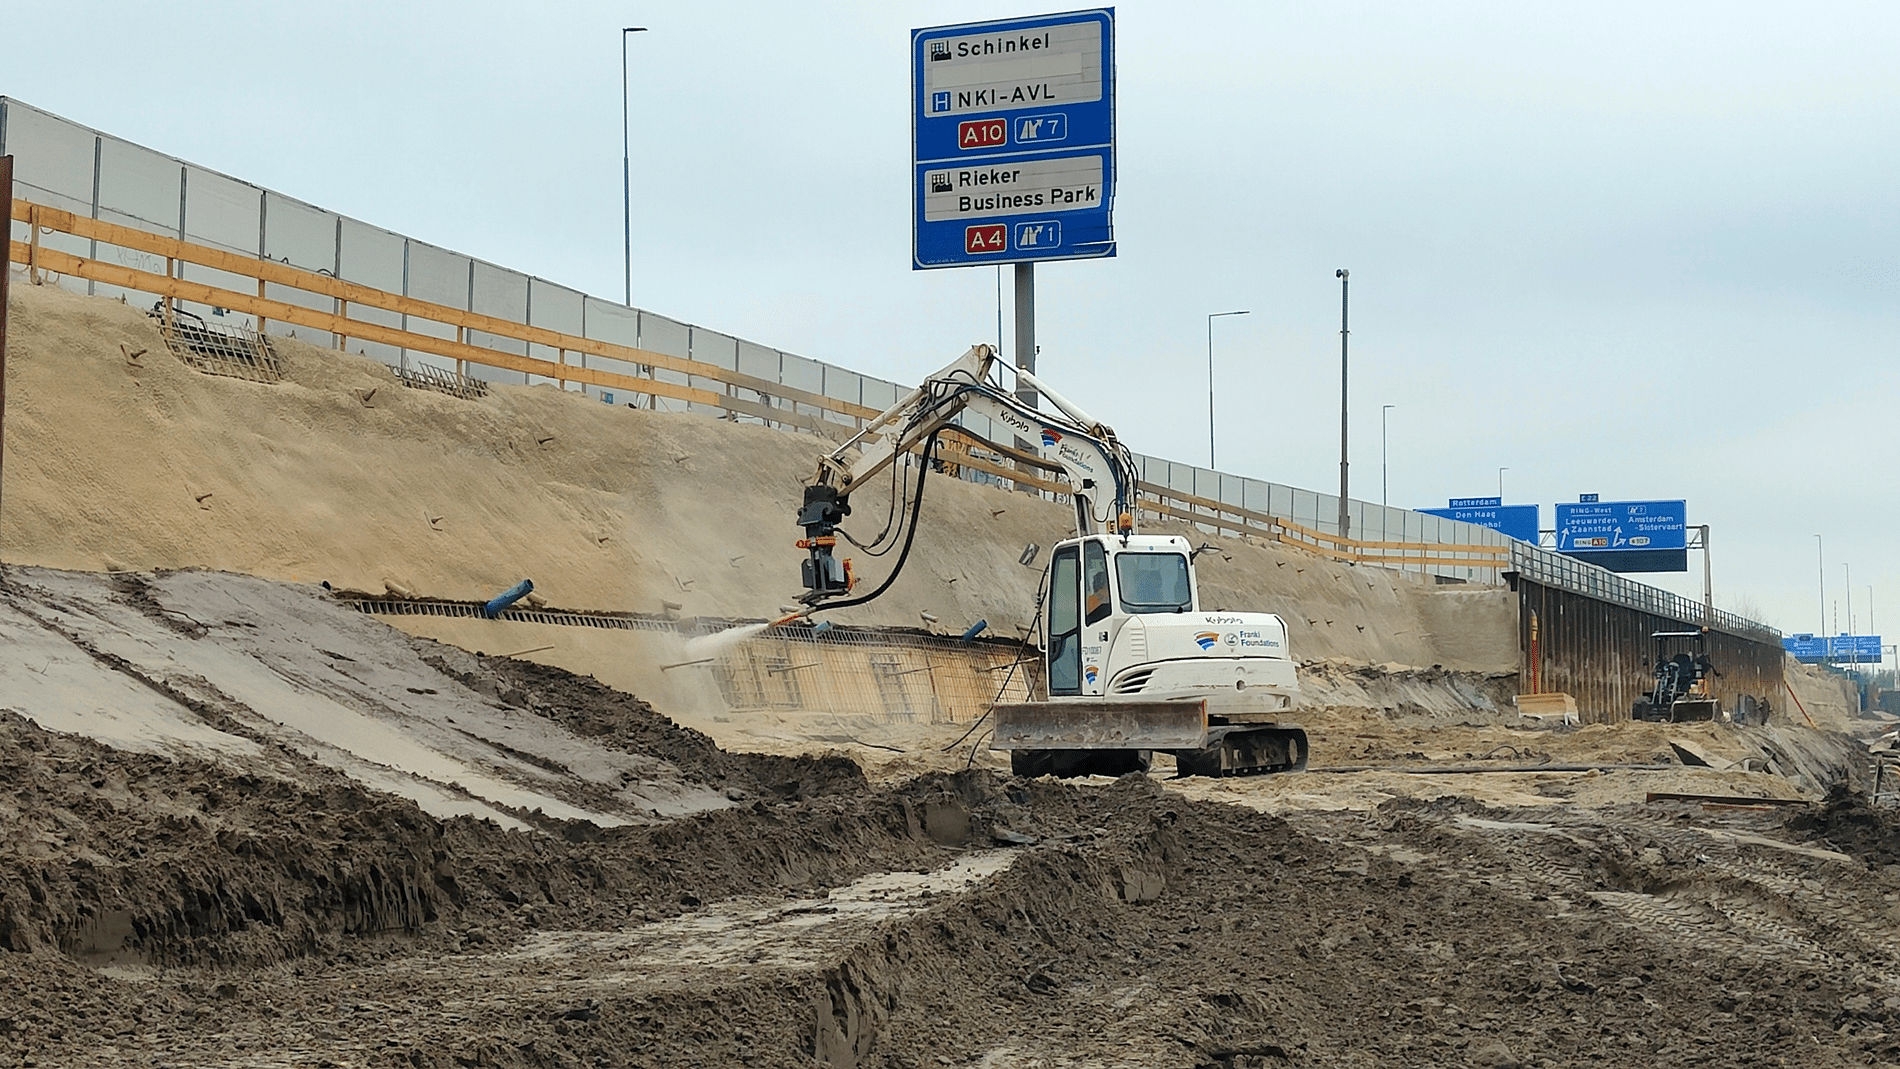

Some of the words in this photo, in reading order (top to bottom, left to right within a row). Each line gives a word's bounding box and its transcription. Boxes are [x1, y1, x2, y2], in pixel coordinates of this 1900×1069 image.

[957, 33, 1050, 57] Schinkel
[935, 94, 949, 111] H
[958, 83, 1056, 108] NKI-AVL
[964, 125, 1002, 144] A10
[1047, 120, 1059, 135] 7
[959, 168, 1021, 187] Rieker
[959, 192, 1044, 212] Business
[1051, 185, 1095, 204] Park
[971, 230, 1002, 248] A4
[1048, 227, 1054, 242] 1
[1000, 410, 1029, 432] Kubota
[1452, 499, 1497, 507] Rotterdam
[1455, 511, 1472, 519] Den
[1474, 511, 1496, 519] Haag
[1565, 517, 1618, 525] Leeuwarden
[1628, 515, 1674, 523] Amsterdam
[1571, 525, 1612, 533] Zaanstad
[1205, 616, 1243, 624] Kubota
[1240, 630, 1260, 638] Franki
[1240, 639, 1279, 648] Foundations
